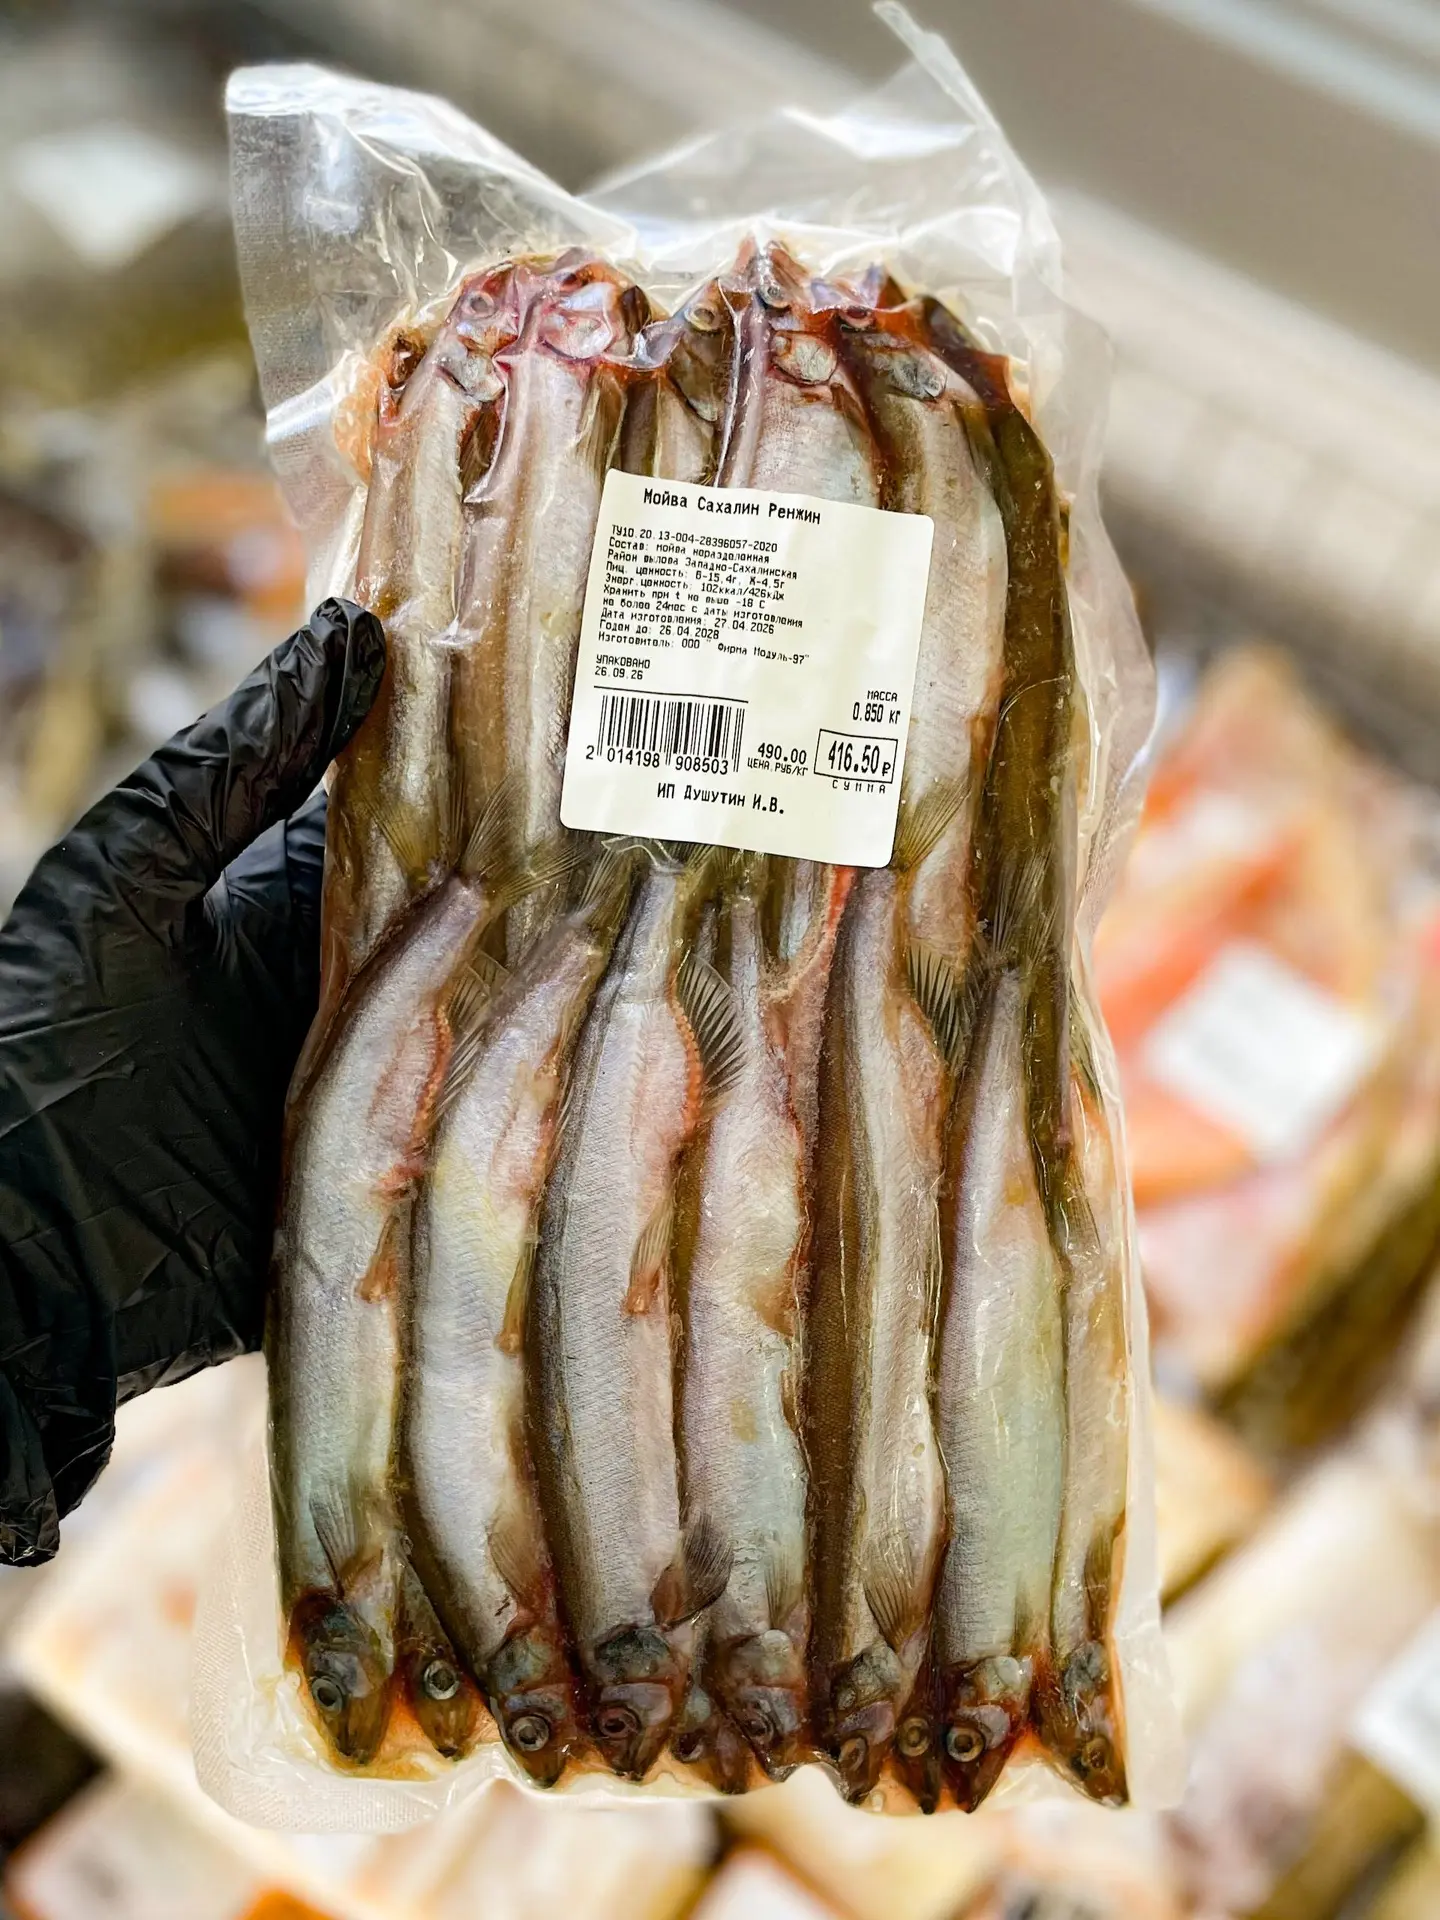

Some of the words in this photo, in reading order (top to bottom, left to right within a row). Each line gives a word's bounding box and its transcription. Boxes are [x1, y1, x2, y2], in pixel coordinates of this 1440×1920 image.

[643, 487, 688, 509] Мойва
[697, 496, 760, 516] Сахалин
[768, 502, 821, 525] Ренжин
[609, 536, 649, 551] Состав:
[656, 543, 686, 554] мойва
[607, 548, 638, 563] Район
[643, 554, 679, 566] вылова
[685, 557, 798, 580] Западно-Сахалинская
[603, 584, 646, 598] Хранить
[651, 591, 670, 600] при
[675, 591, 680, 600] t
[687, 594, 700, 602] не
[736, 597, 754, 608] -18
[600, 607, 625, 619] Дата
[630, 612, 707, 626] изготовления:
[714, 617, 776, 635] 27.04.2026
[602, 598, 615, 606] не
[620, 599, 651, 610] более
[656, 601, 686, 612] 24мес
[691, 605, 698, 613] с
[703, 607, 727, 617] даты
[733, 610, 804, 629] изготовления
[598, 631, 674, 648] Изготовитель:
[681, 638, 701, 649] ООО
[599, 619, 631, 632] Годен
[635, 625, 652, 635] до:
[659, 625, 720, 640] 26.04.2028
[594, 666, 644, 680] 26.09.26
[595, 654, 651, 669] УПАКОВАНО
[867, 690, 898, 702] МАССА
[852, 701, 884, 723] 0.850
[585, 745, 595, 760] 2
[606, 747, 661, 768] 014198
[675, 756, 729, 775] 908503
[757, 742, 807, 765] 490.00
[657, 782, 676, 799] ИП
[684, 784, 746, 807] Душутин
[752, 793, 785, 815] И.В.
